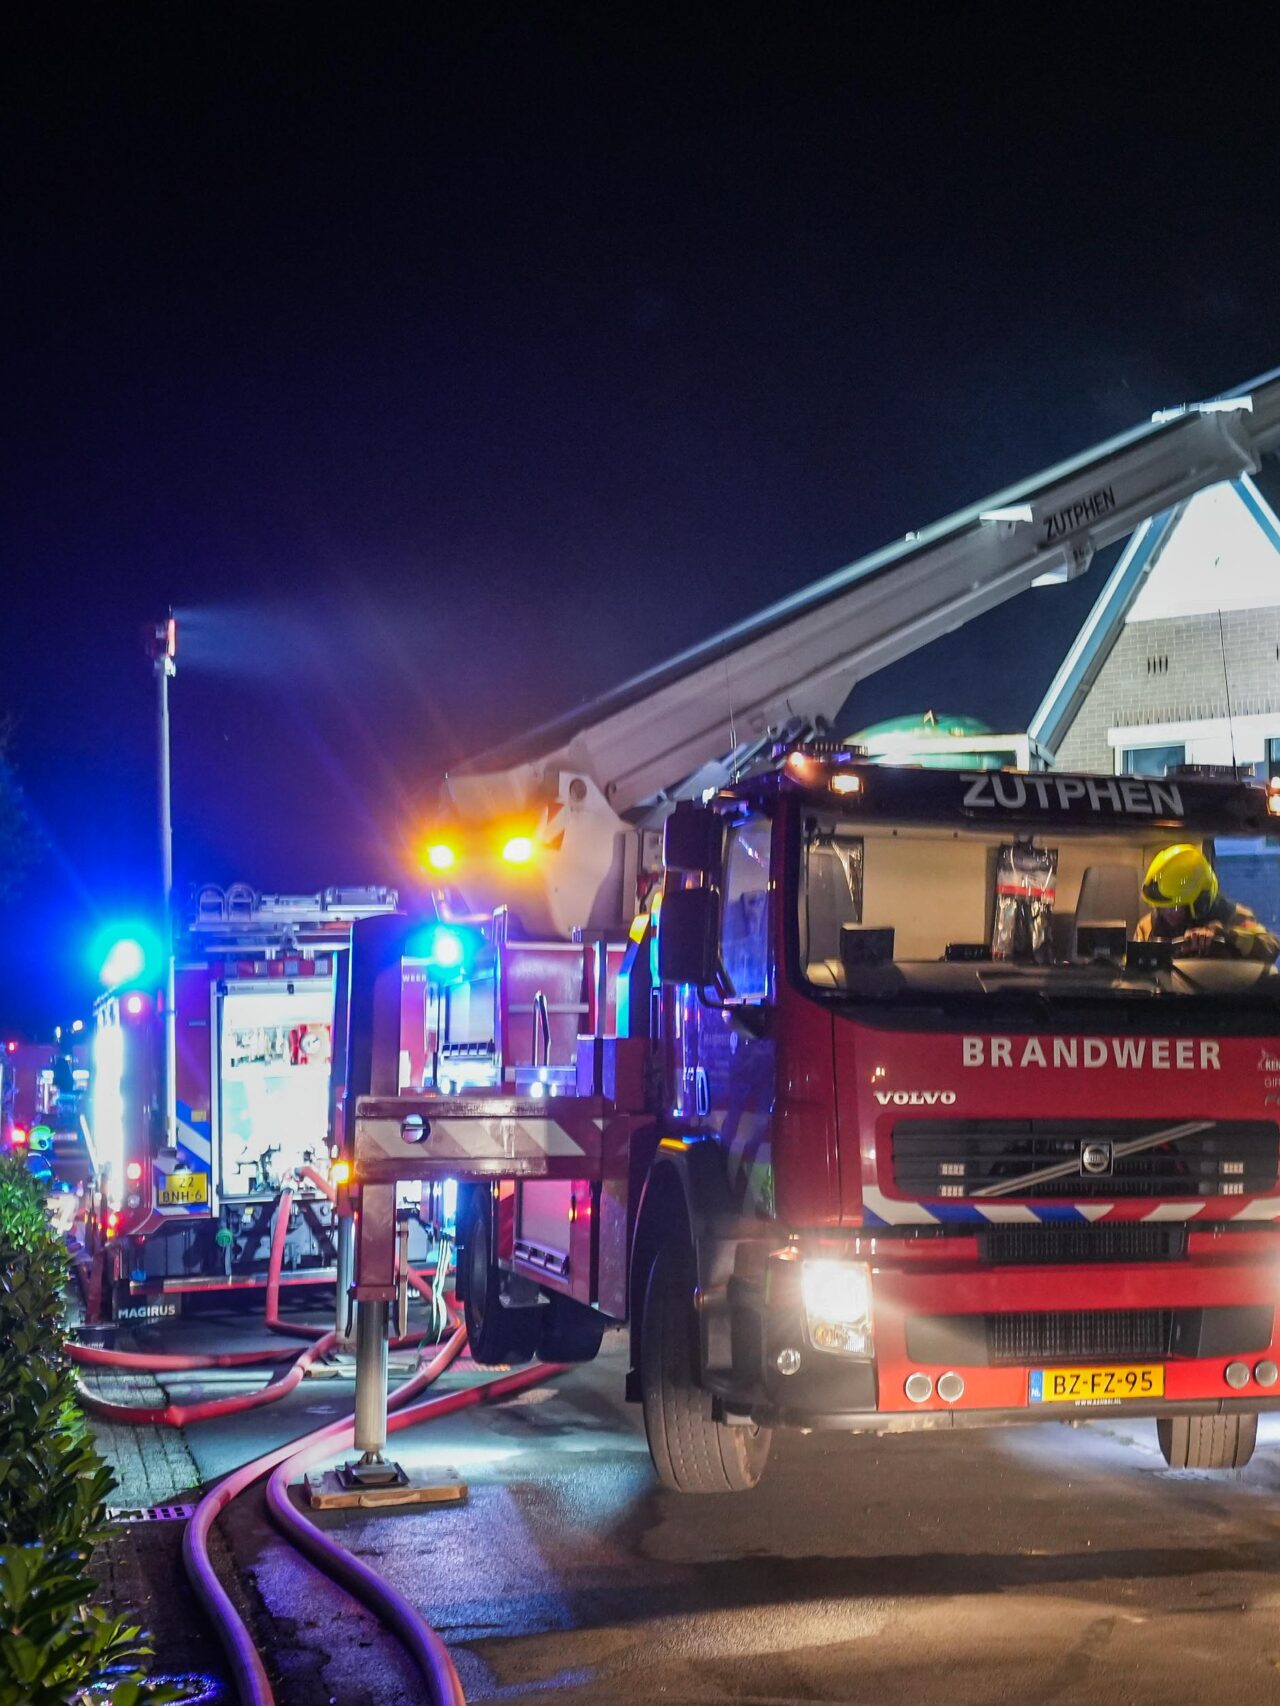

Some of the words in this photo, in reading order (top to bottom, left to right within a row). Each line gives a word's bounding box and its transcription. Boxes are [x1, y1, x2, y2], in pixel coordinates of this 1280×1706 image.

[1043, 484, 1116, 541] ZUTPHEN
[959, 773, 1184, 816] ZUTPHEN
[962, 1036, 1221, 1070] BRANDWEER
[873, 1090, 956, 1105] VOLVO
[179, 1176, 194, 1189] 22
[162, 1190, 202, 1203] BNH-6
[118, 1304, 176, 1319] MAGIRUS
[1031, 1388, 1041, 1397] NL
[1053, 1370, 1153, 1395] BZ-FZ-95
